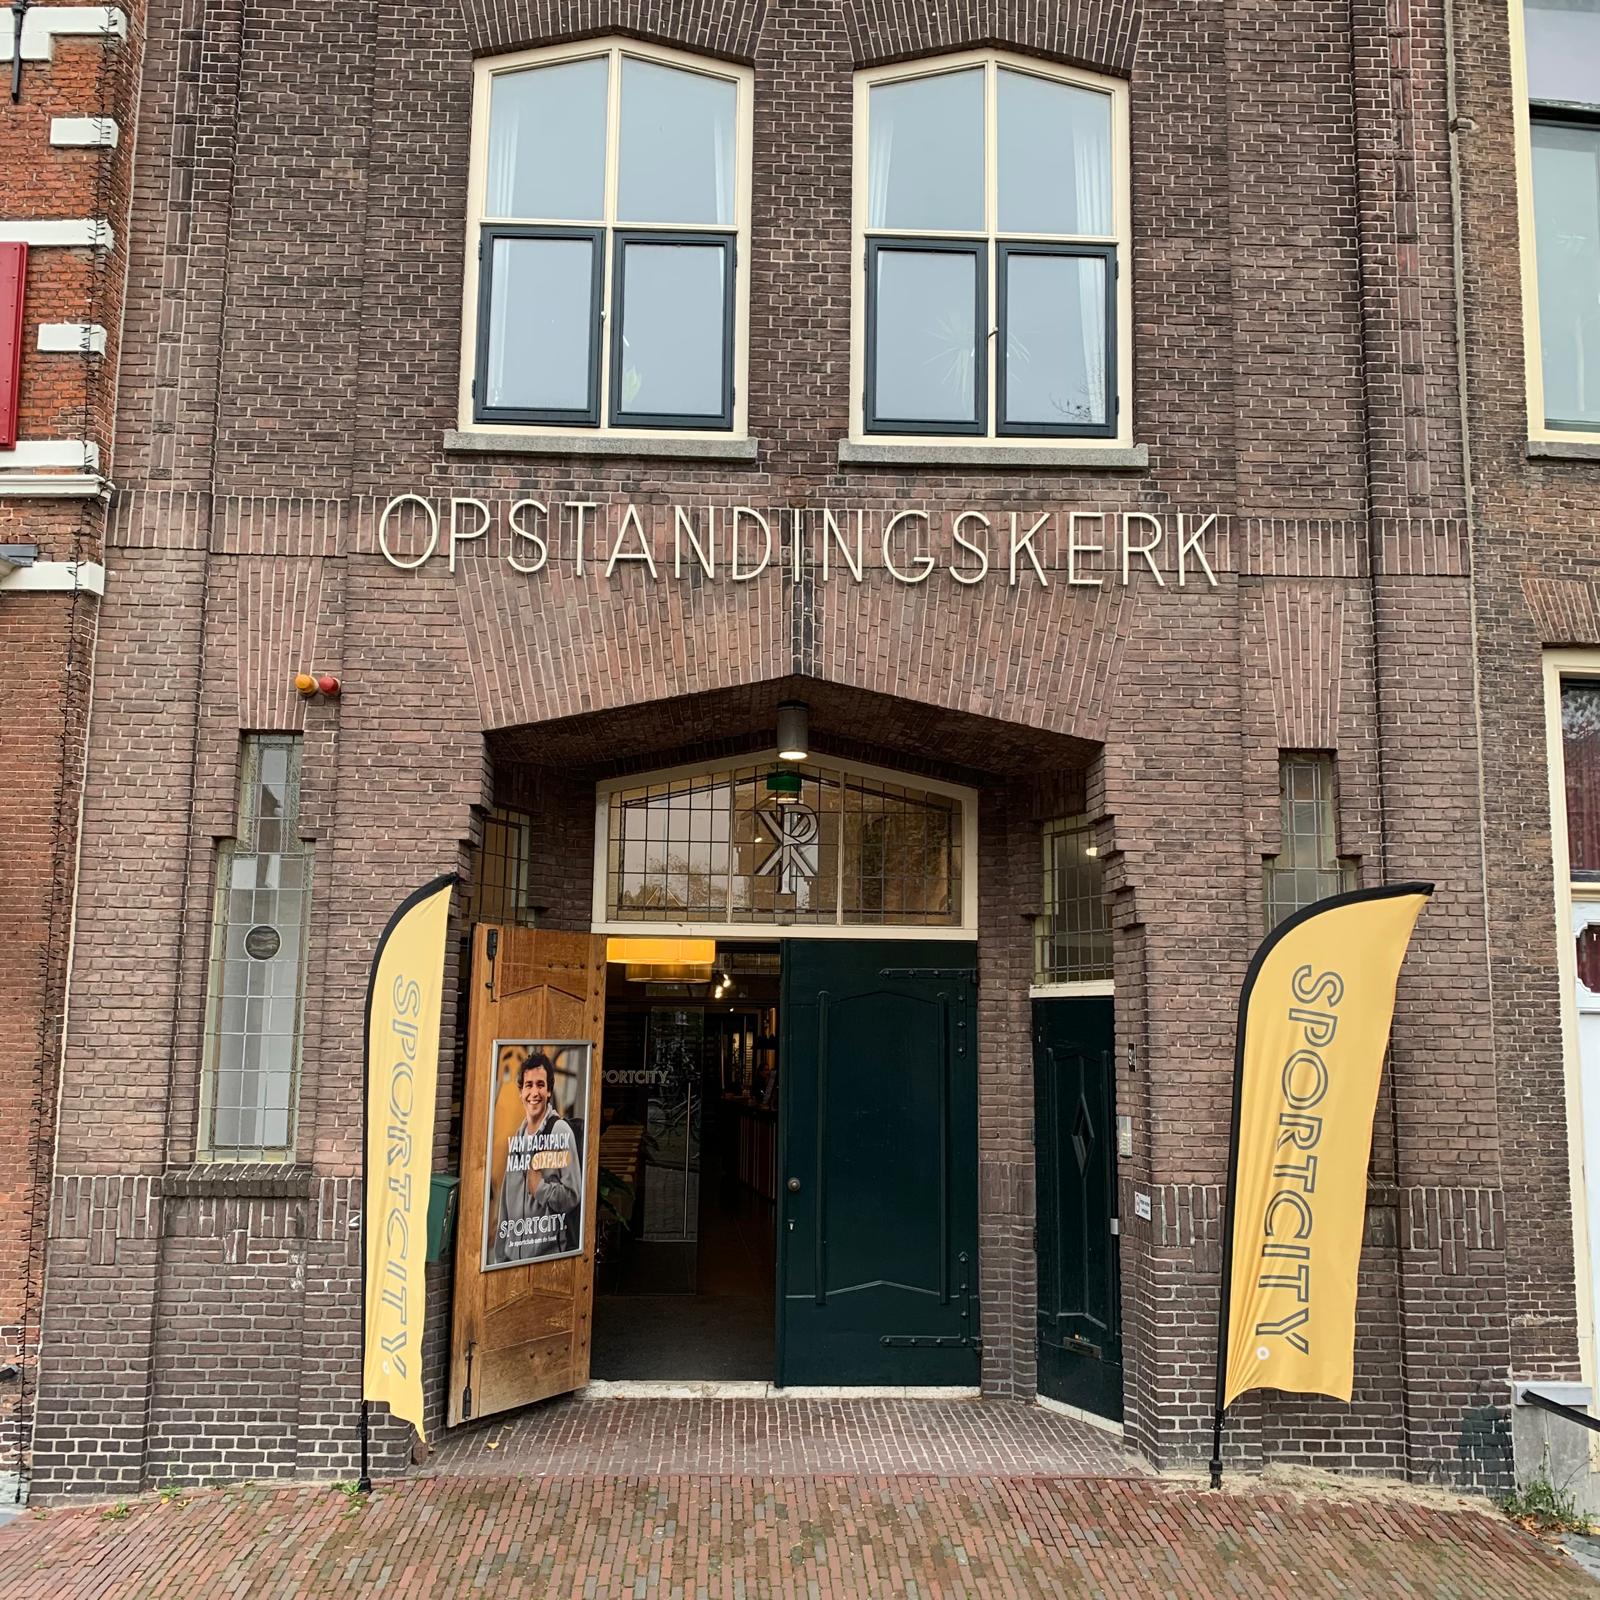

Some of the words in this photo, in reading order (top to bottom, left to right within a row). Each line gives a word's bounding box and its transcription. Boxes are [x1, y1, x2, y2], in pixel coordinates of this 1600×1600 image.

[377, 493, 1221, 589] OPSTANDINGSKERK
[507, 1135, 525, 1154] VAN
[527, 1133, 570, 1152] BACKPACK
[506, 1153, 531, 1172] NAAR
[532, 1150, 568, 1170] SIXPACK
